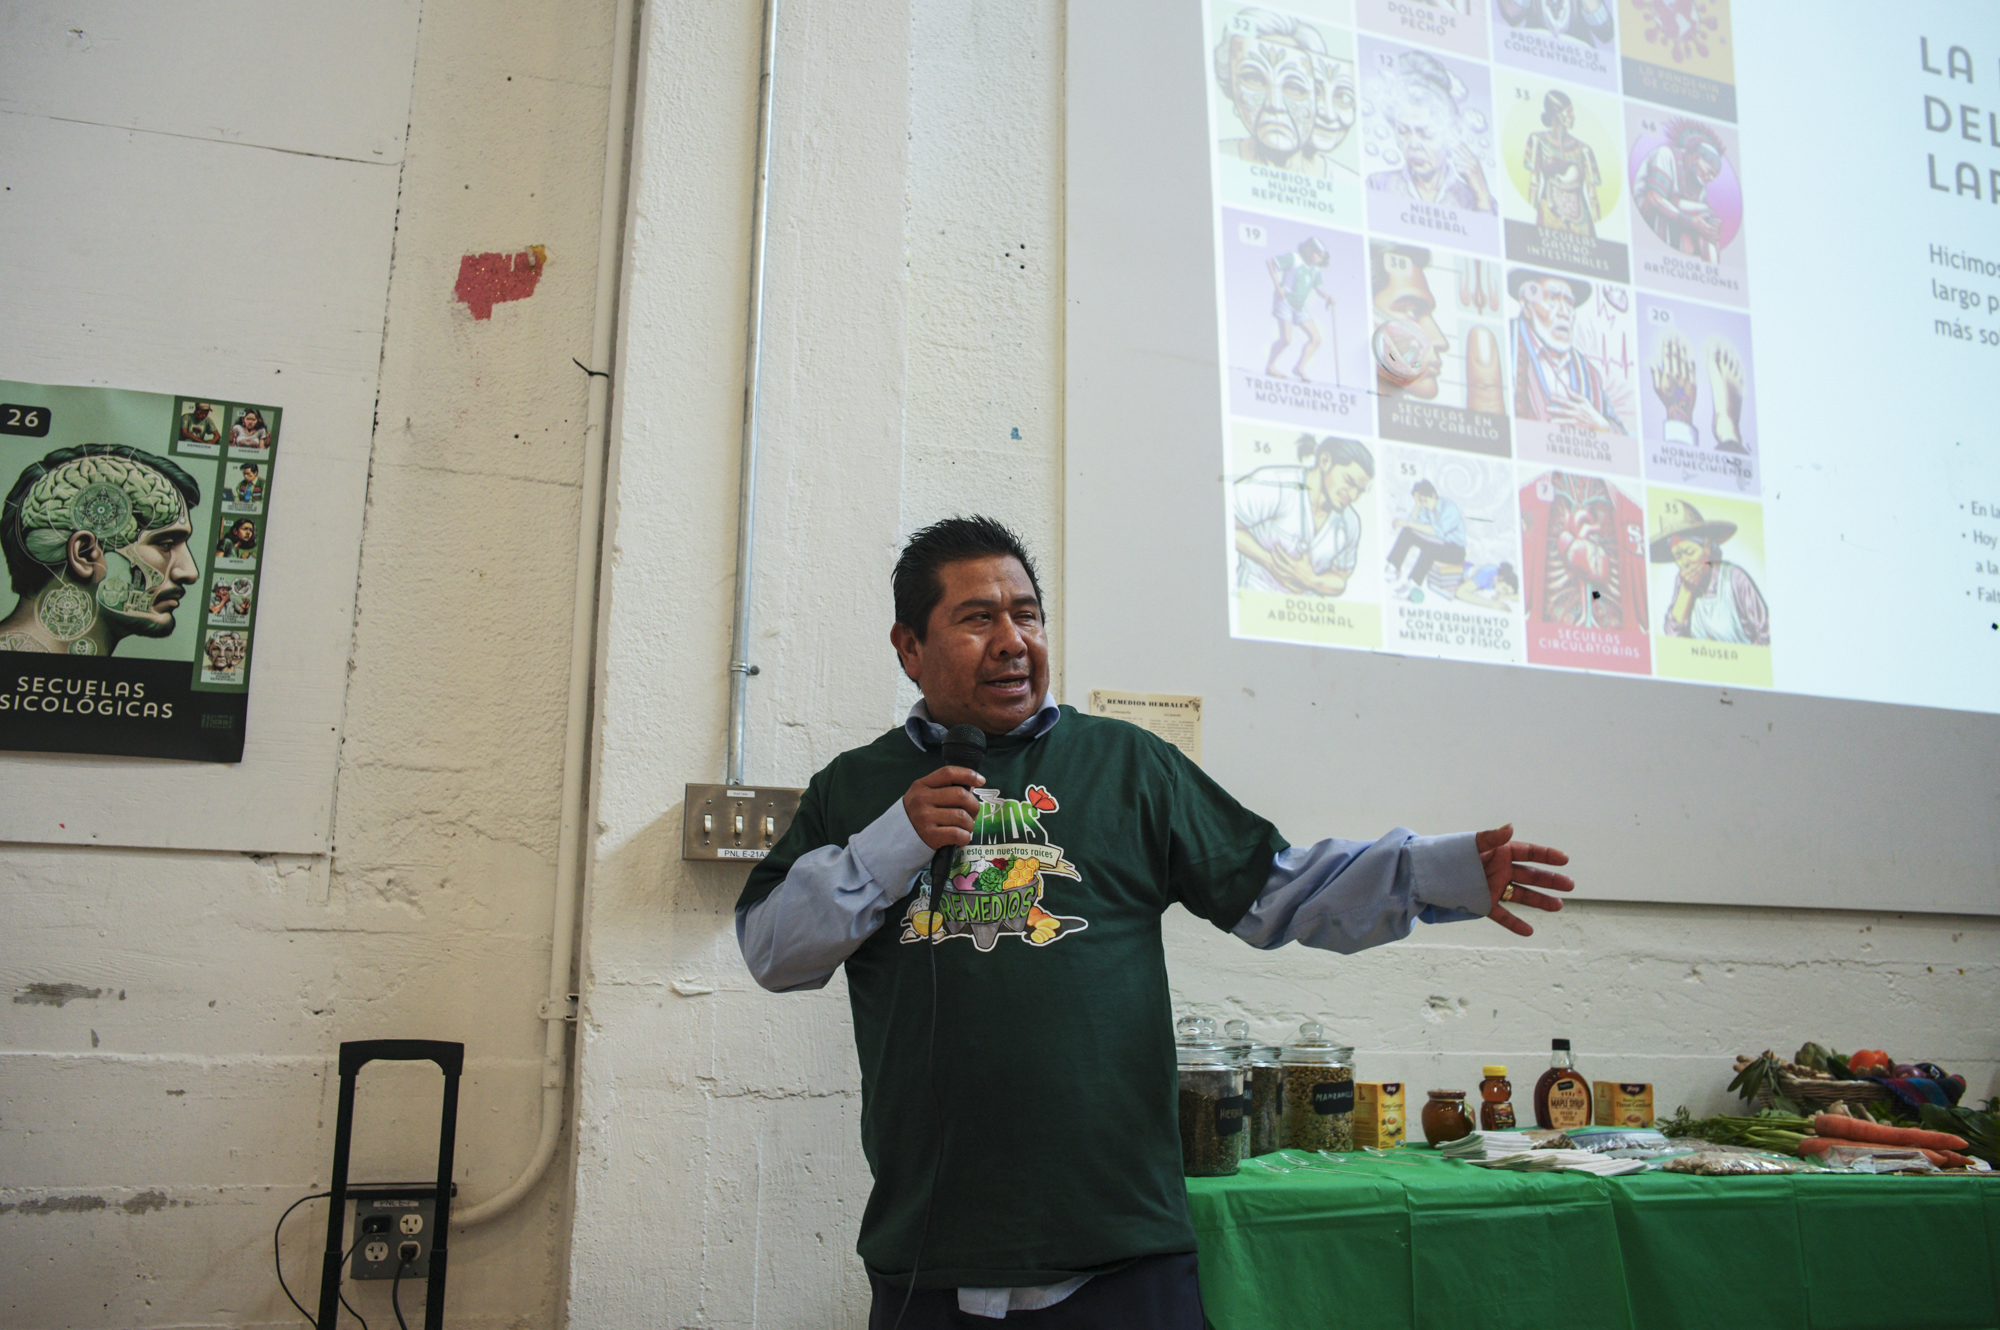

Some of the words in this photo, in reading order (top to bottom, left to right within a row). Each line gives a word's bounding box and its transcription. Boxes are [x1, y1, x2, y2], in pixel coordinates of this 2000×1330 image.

[1388, 1, 1434, 21] DOLOR
[1441, 14, 1456, 27] DE
[1233, 18, 1250, 31] 32
[1402, 17, 1446, 36] PECHO
[1511, 31, 1582, 56] PROBLEMAS
[1585, 48, 1599, 61] DE
[1380, 54, 1394, 67] 12
[1504, 39, 1607, 74] CONCENTRACIÓN
[1919, 35, 1974, 84] LA
[1515, 88, 1530, 101] 33
[1641, 120, 1656, 132] 46
[1923, 94, 2000, 148] DEL
[1250, 165, 1311, 190] CAMBIOS
[1317, 179, 1334, 192] DE
[1268, 179, 1317, 198] HUMOR
[1251, 187, 1335, 214] REPENTINOS
[1410, 202, 1458, 220] NIEBLA
[1245, 227, 1261, 240] 19
[1400, 212, 1468, 236] CEREBRAL
[1389, 256, 1406, 270] 38
[1663, 255, 1702, 272] DOLOR
[1705, 264, 1719, 276] DE
[1644, 262, 1739, 291] ARTICULACIONES
[1932, 277, 1981, 310] largo
[1652, 309, 1669, 322] 20
[1934, 317, 1973, 342] más
[1245, 376, 1334, 401] TRASTORNO
[1340, 393, 1357, 406] DE
[1255, 391, 1350, 415] MOVIMIENTO
[6, 408, 39, 427] 26
[1398, 402, 1465, 423] SECUELAS
[1475, 415, 1491, 427] EN
[1392, 413, 1419, 428] PIEL
[1439, 421, 1499, 439] CABELLO
[1560, 425, 1596, 439] RITMO
[1253, 440, 1271, 454] 36
[1546, 443, 1611, 462] IRREGULAR
[1652, 453, 1753, 479] ENTUMECIMIENTO
[1971, 500, 1988, 517] En
[1973, 529, 1998, 551] Hoy
[1975, 561, 1985, 573] a
[1987, 560, 2000, 575] la
[1286, 599, 1336, 615] DOLOR
[1267, 609, 1354, 629] ABDOMINAL
[1399, 607, 1509, 629] EMPEORAMIENTO
[1399, 630, 1450, 644] MENTAL
[1456, 635, 1466, 645] O
[1406, 619, 1434, 631] CON
[1440, 622, 1504, 639] ESFUERZO
[1558, 629, 1621, 646] SECUELAS
[1538, 638, 1640, 659] CIRCULATORIAS
[17, 676, 145, 698] SECUELAS
[1149, 701, 1189, 709] HERBALES
[985, 848, 994, 856] en
[997, 846, 1028, 856] nuestras
[939, 885, 1035, 922] REMEDIOS
